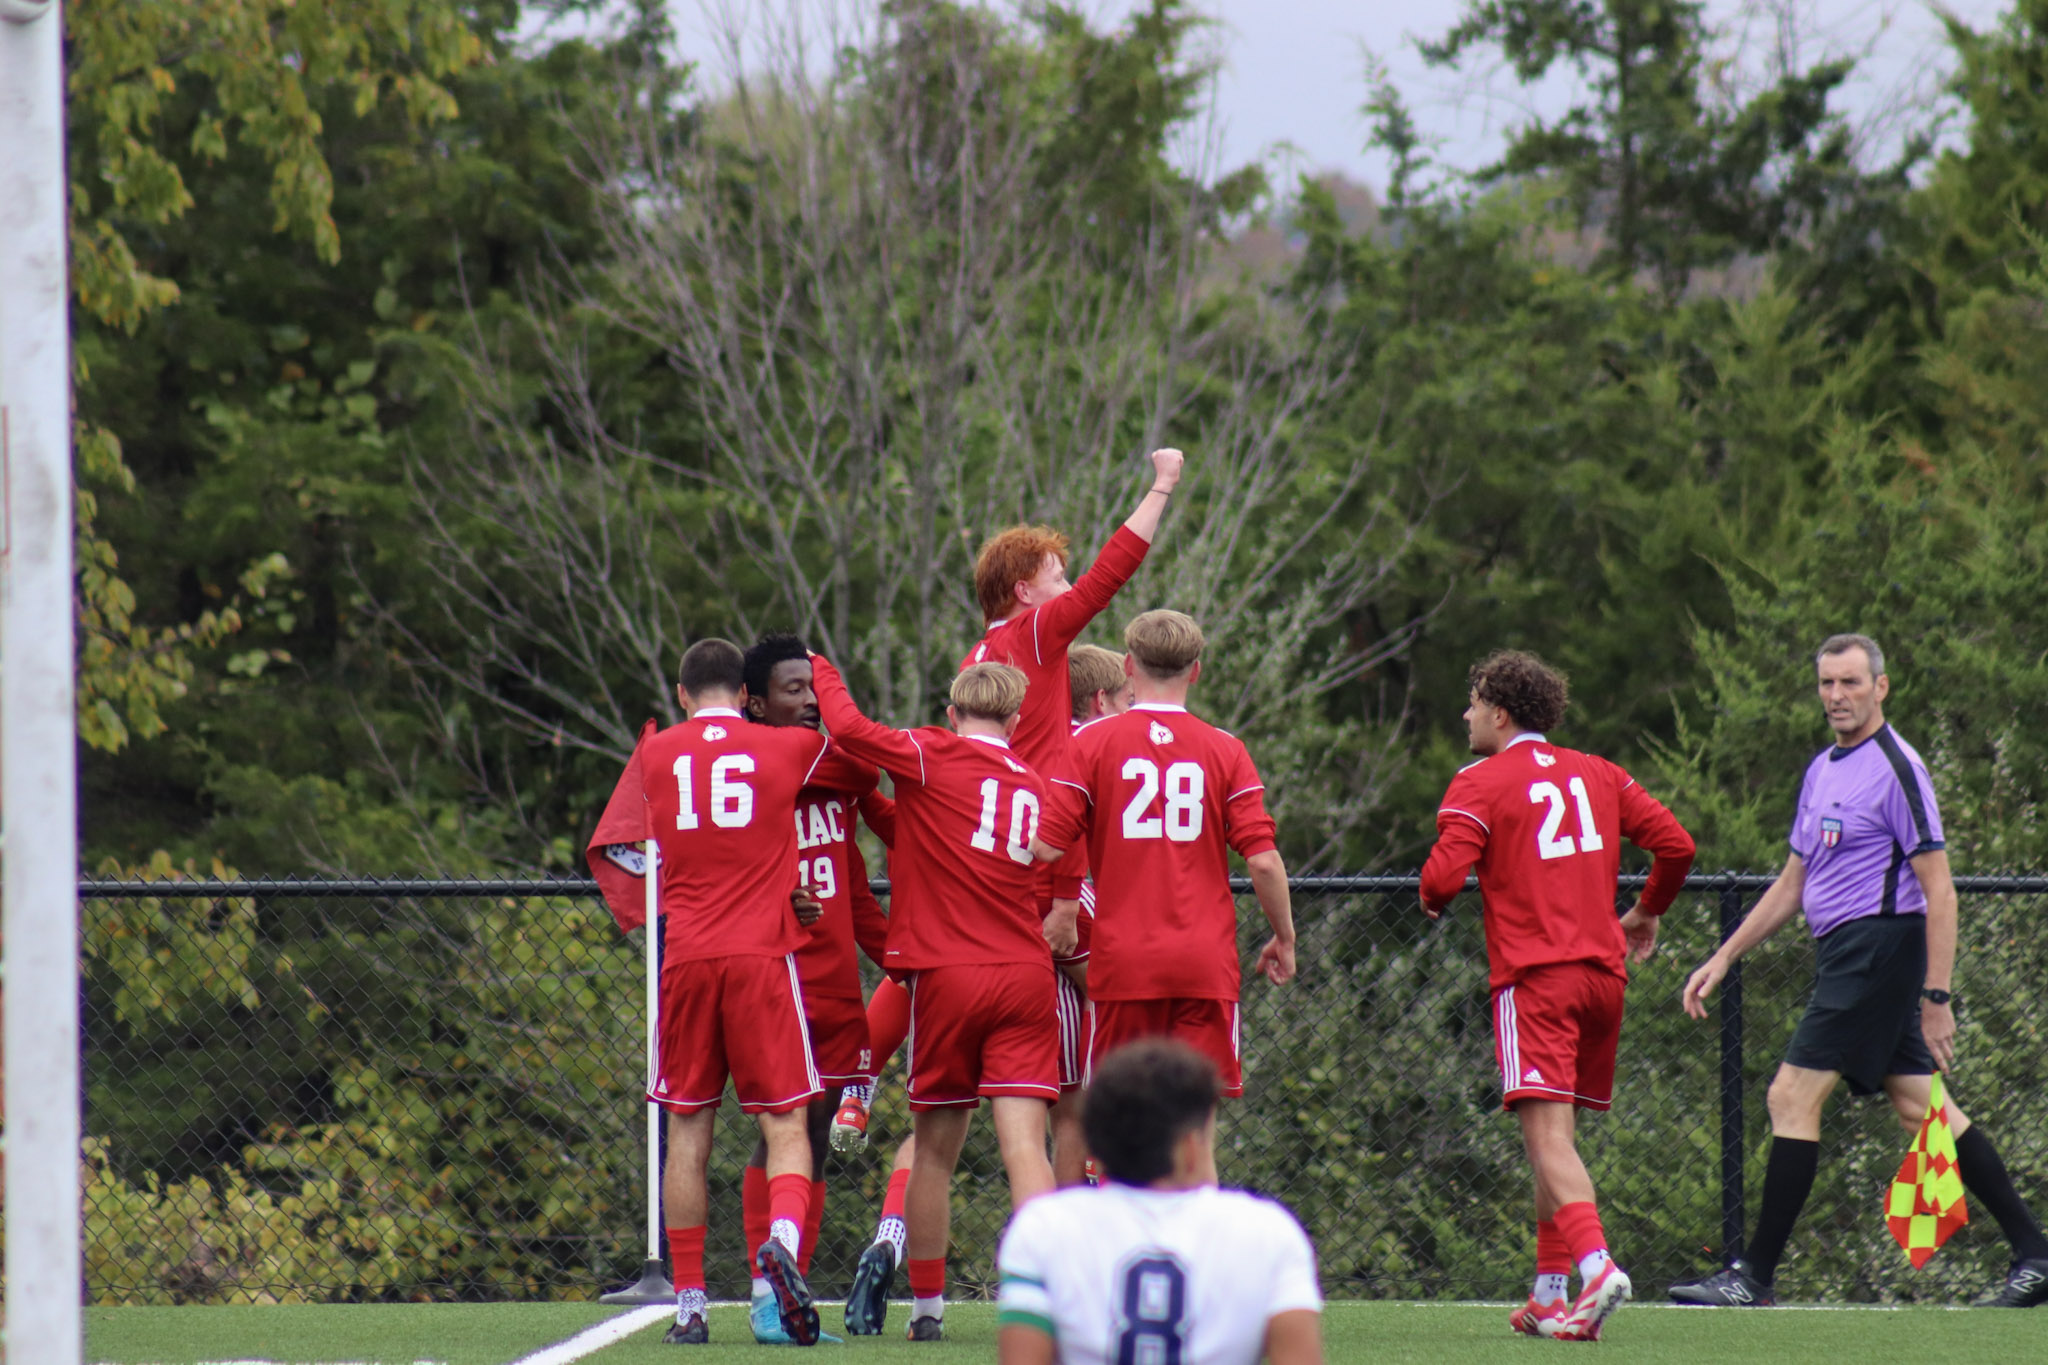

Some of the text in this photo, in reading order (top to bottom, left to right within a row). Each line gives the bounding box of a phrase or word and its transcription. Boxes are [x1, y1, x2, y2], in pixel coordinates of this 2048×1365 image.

[673, 753, 755, 830] 16
[970, 778, 1040, 866] 10
[1121, 757, 1204, 842] 28
[1529, 777, 1604, 860] 21
[798, 856, 836, 899] 19
[1114, 1252, 1192, 1365] 8
